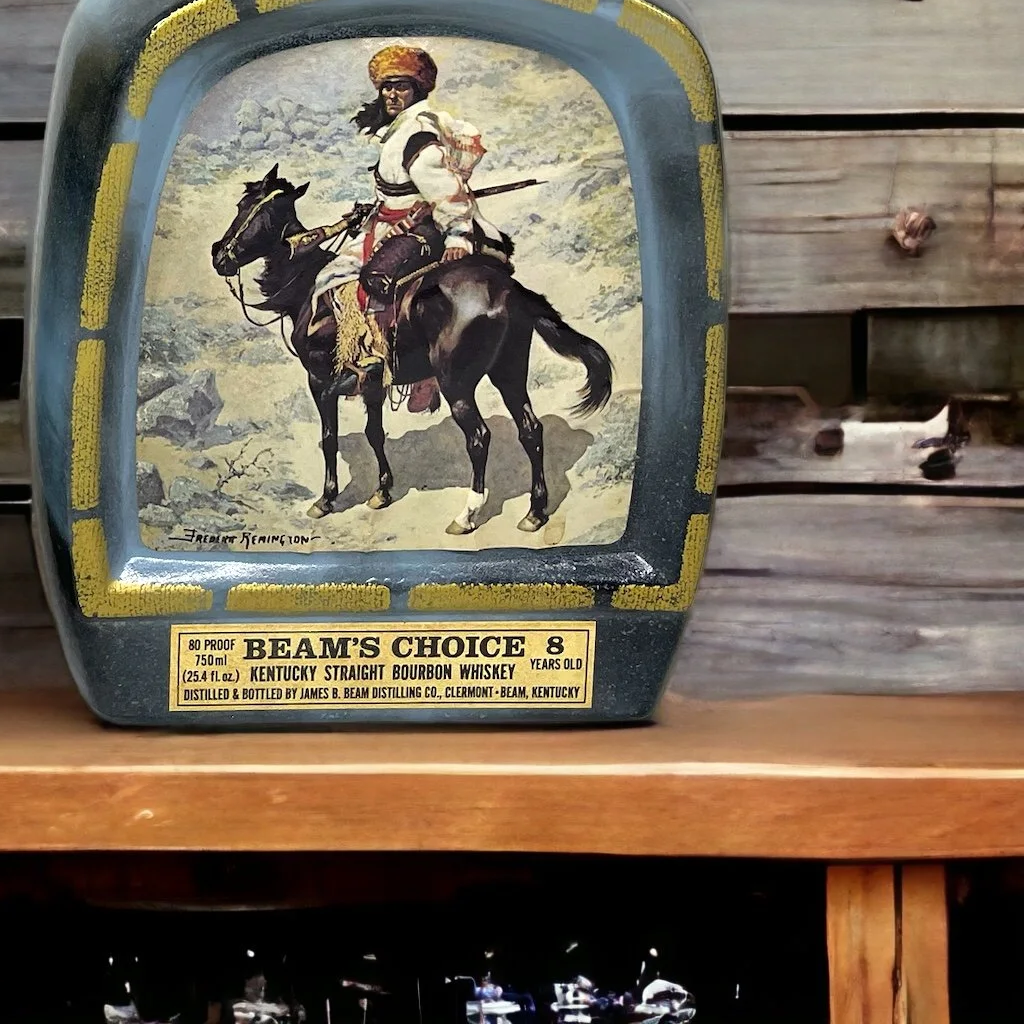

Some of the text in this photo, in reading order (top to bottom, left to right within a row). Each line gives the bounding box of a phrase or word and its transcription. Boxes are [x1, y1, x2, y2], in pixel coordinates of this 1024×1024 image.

[188, 638, 236, 650] 80 PROOF
[243, 636, 564, 660] BEAM'S CHOICE 8
[530, 658, 582, 670] YEARS OLD
[182, 670, 208, 684] (25.4
[250, 664, 516, 682] KENTUCKY STRAIGHT BOURBON WHISKEY
[184, 688, 230, 700] DISTILLED
[232, 688, 240, 700] &
[242, 688, 282, 700] BOTTLED
[286, 688, 298, 699] BY
[300, 688, 329, 700] JAMES
[332, 688, 341, 699] B.
[344, 688, 370, 699] BEAM
[372, 686, 422, 699] DISTILLING
[532, 686, 580, 699] KENTUCKY
